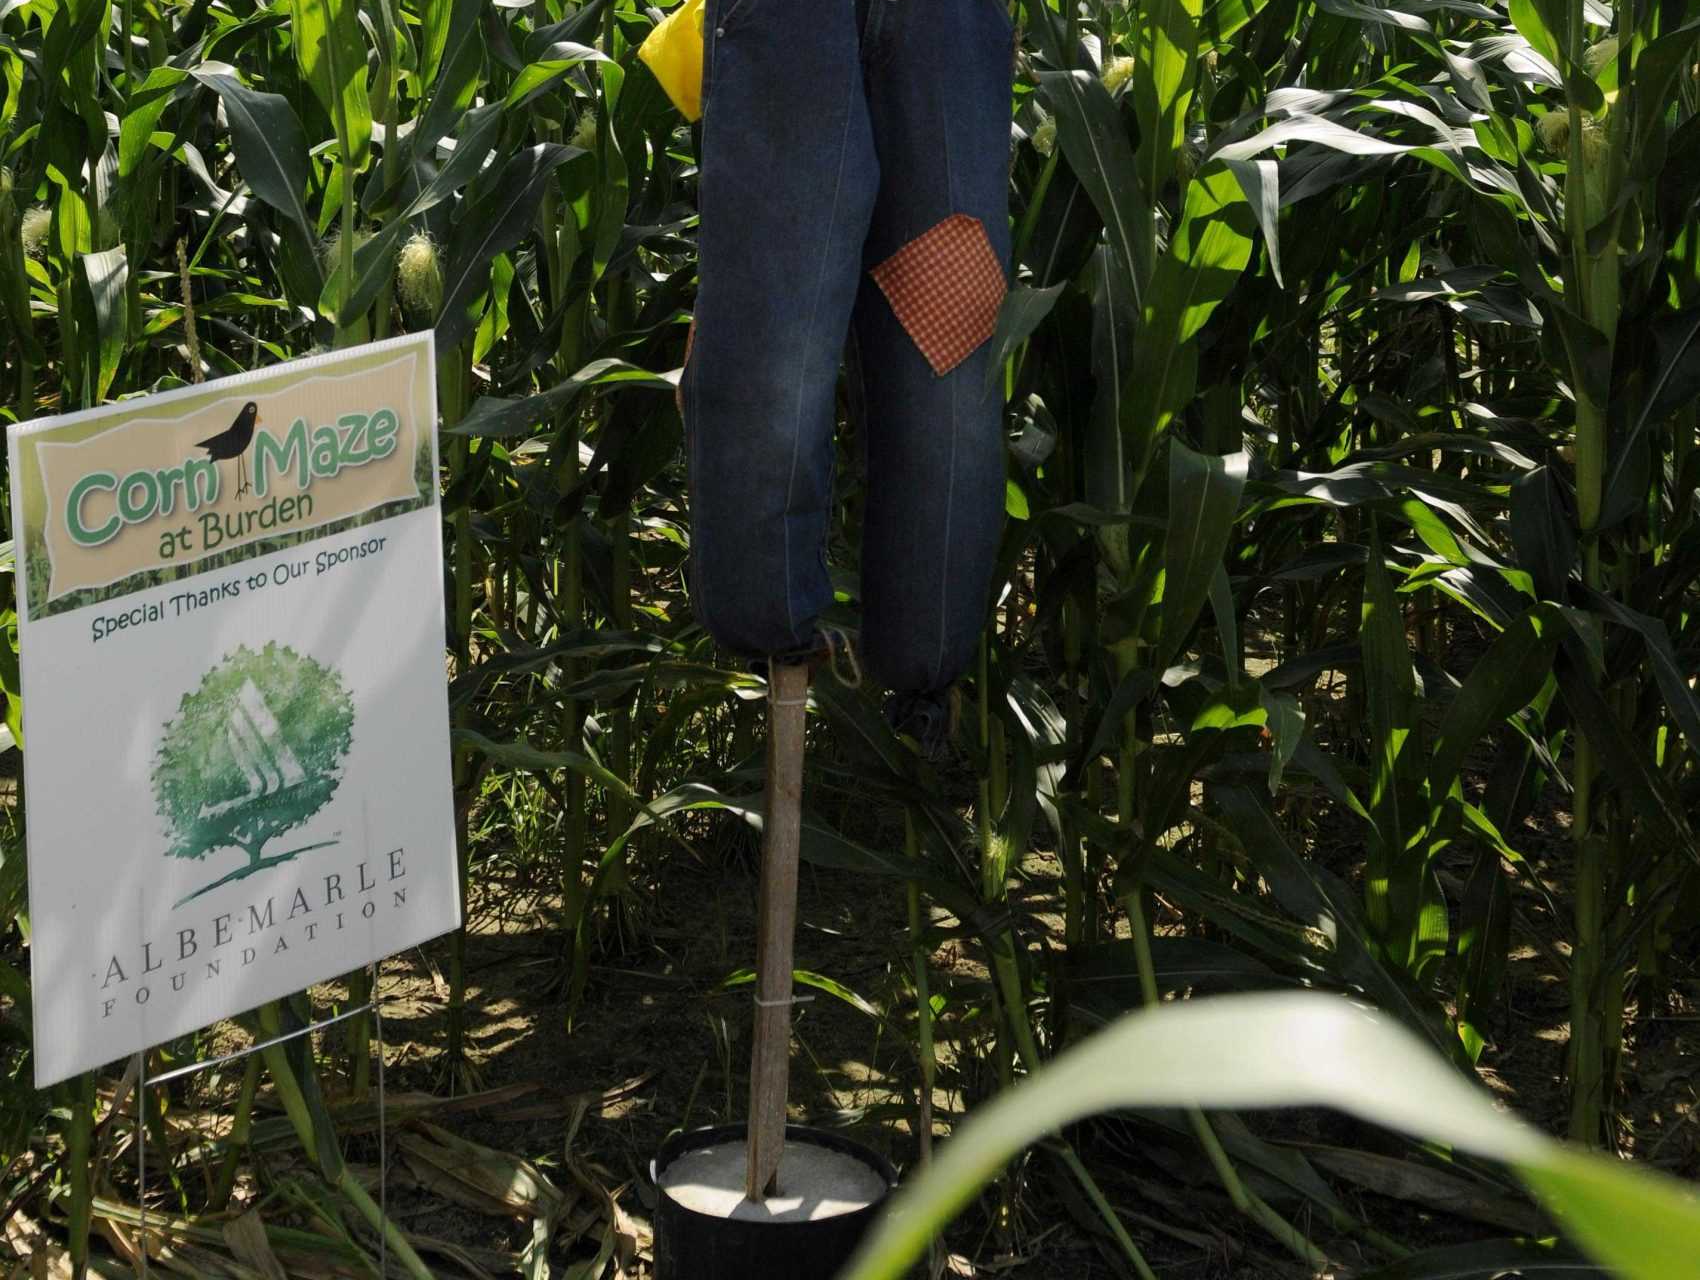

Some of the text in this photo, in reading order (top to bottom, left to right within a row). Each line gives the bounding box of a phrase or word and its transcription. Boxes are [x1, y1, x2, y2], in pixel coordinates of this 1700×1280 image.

[65, 407, 399, 546] Corn Maze
[159, 494, 314, 559] at Burden
[91, 537, 387, 643] Special Thanks to Our Sponsor
[100, 847, 406, 989] ALBEMARLE
[102, 888, 407, 1018] FOUNDATION
